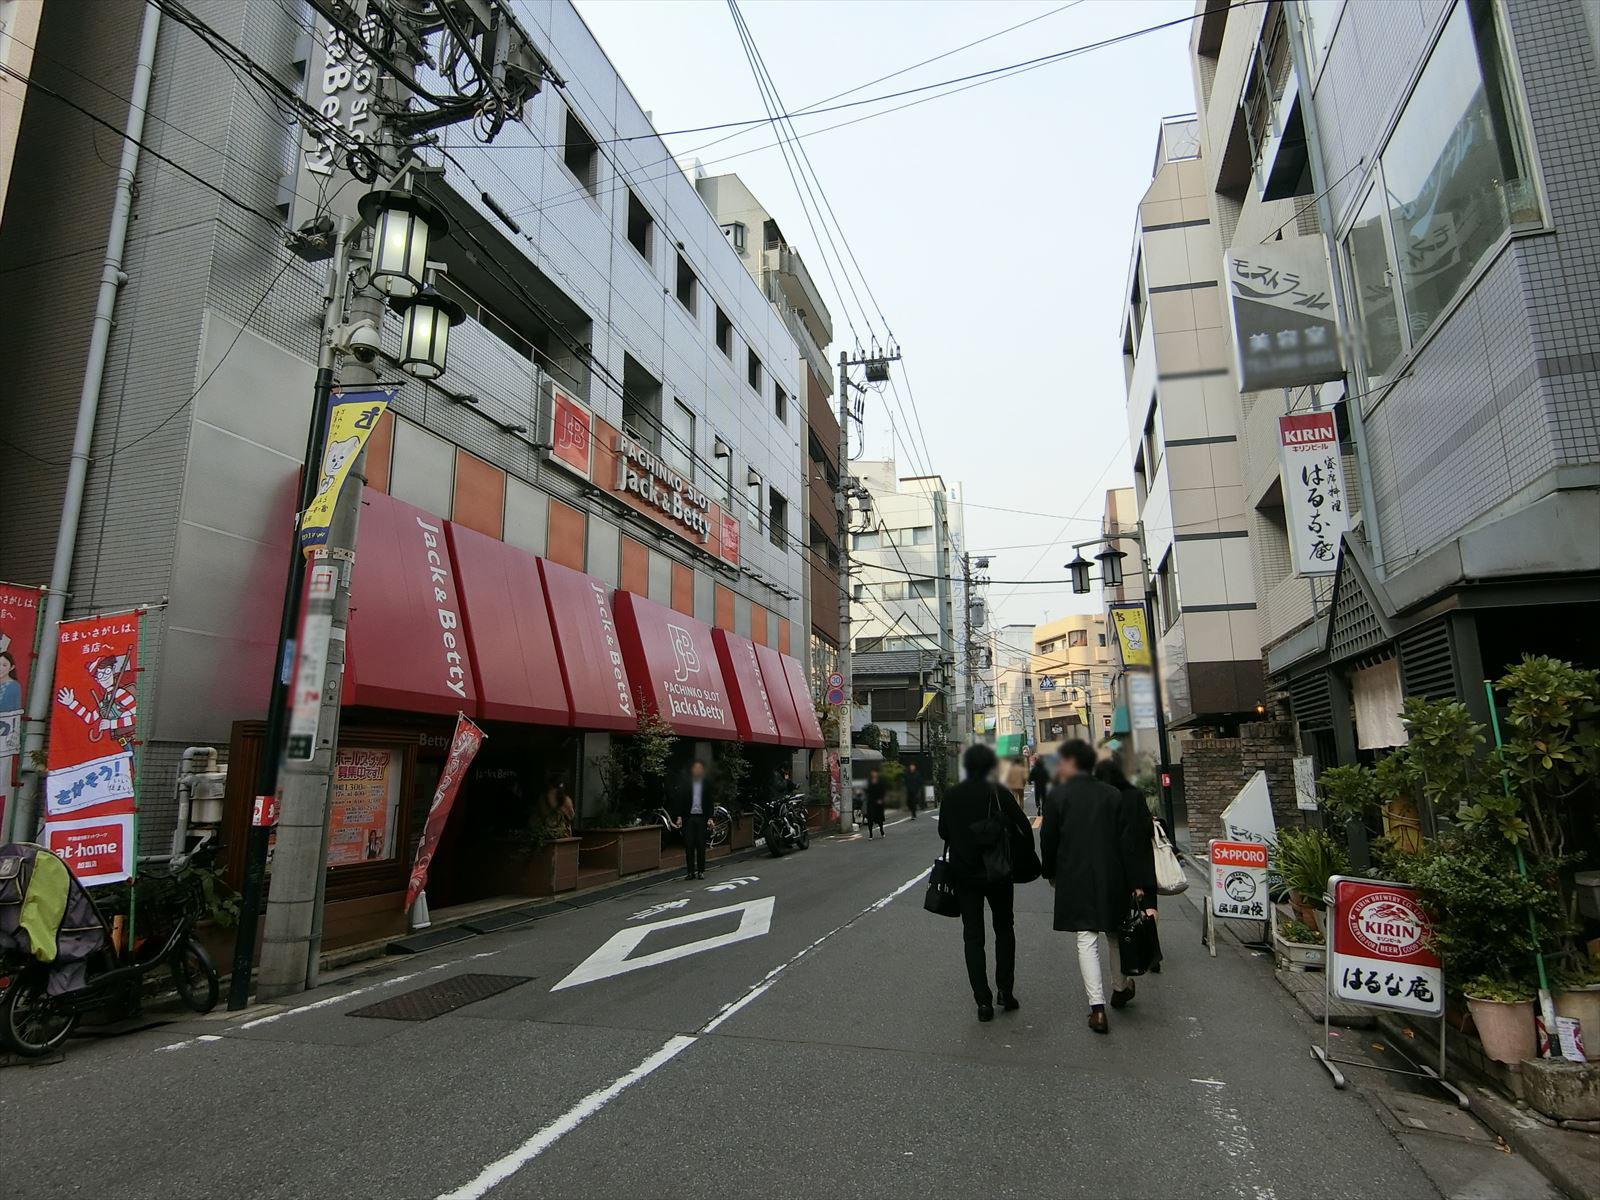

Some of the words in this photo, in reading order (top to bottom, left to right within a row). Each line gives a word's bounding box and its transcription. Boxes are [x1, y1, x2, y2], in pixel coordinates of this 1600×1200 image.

[1284, 426, 1333, 443] KIRIN
[1292, 443, 1329, 453] キリンビール
[620, 436, 682, 492] PACHINKO
[686, 485, 712, 513] SLOT
[417, 516, 448, 585] Jack
[437, 608, 466, 698] Betty
[61, 623, 136, 643] 住まいさがしは、
[81, 642, 115, 655] 当店へ。
[591, 582, 612, 632] Jack
[608, 650, 632, 716] Betty
[664, 681, 703, 701] PACHINKO
[703, 688, 721, 702] SLOT
[419, 732, 450, 751] Betty
[55, 845, 74, 859] at
[74, 842, 118, 858] home
[1370, 895, 1401, 904] BREWERY
[1365, 921, 1415, 940] KIRIN
[1380, 945, 1399, 953] BEER
[1343, 967, 1435, 1003] はるな庵
